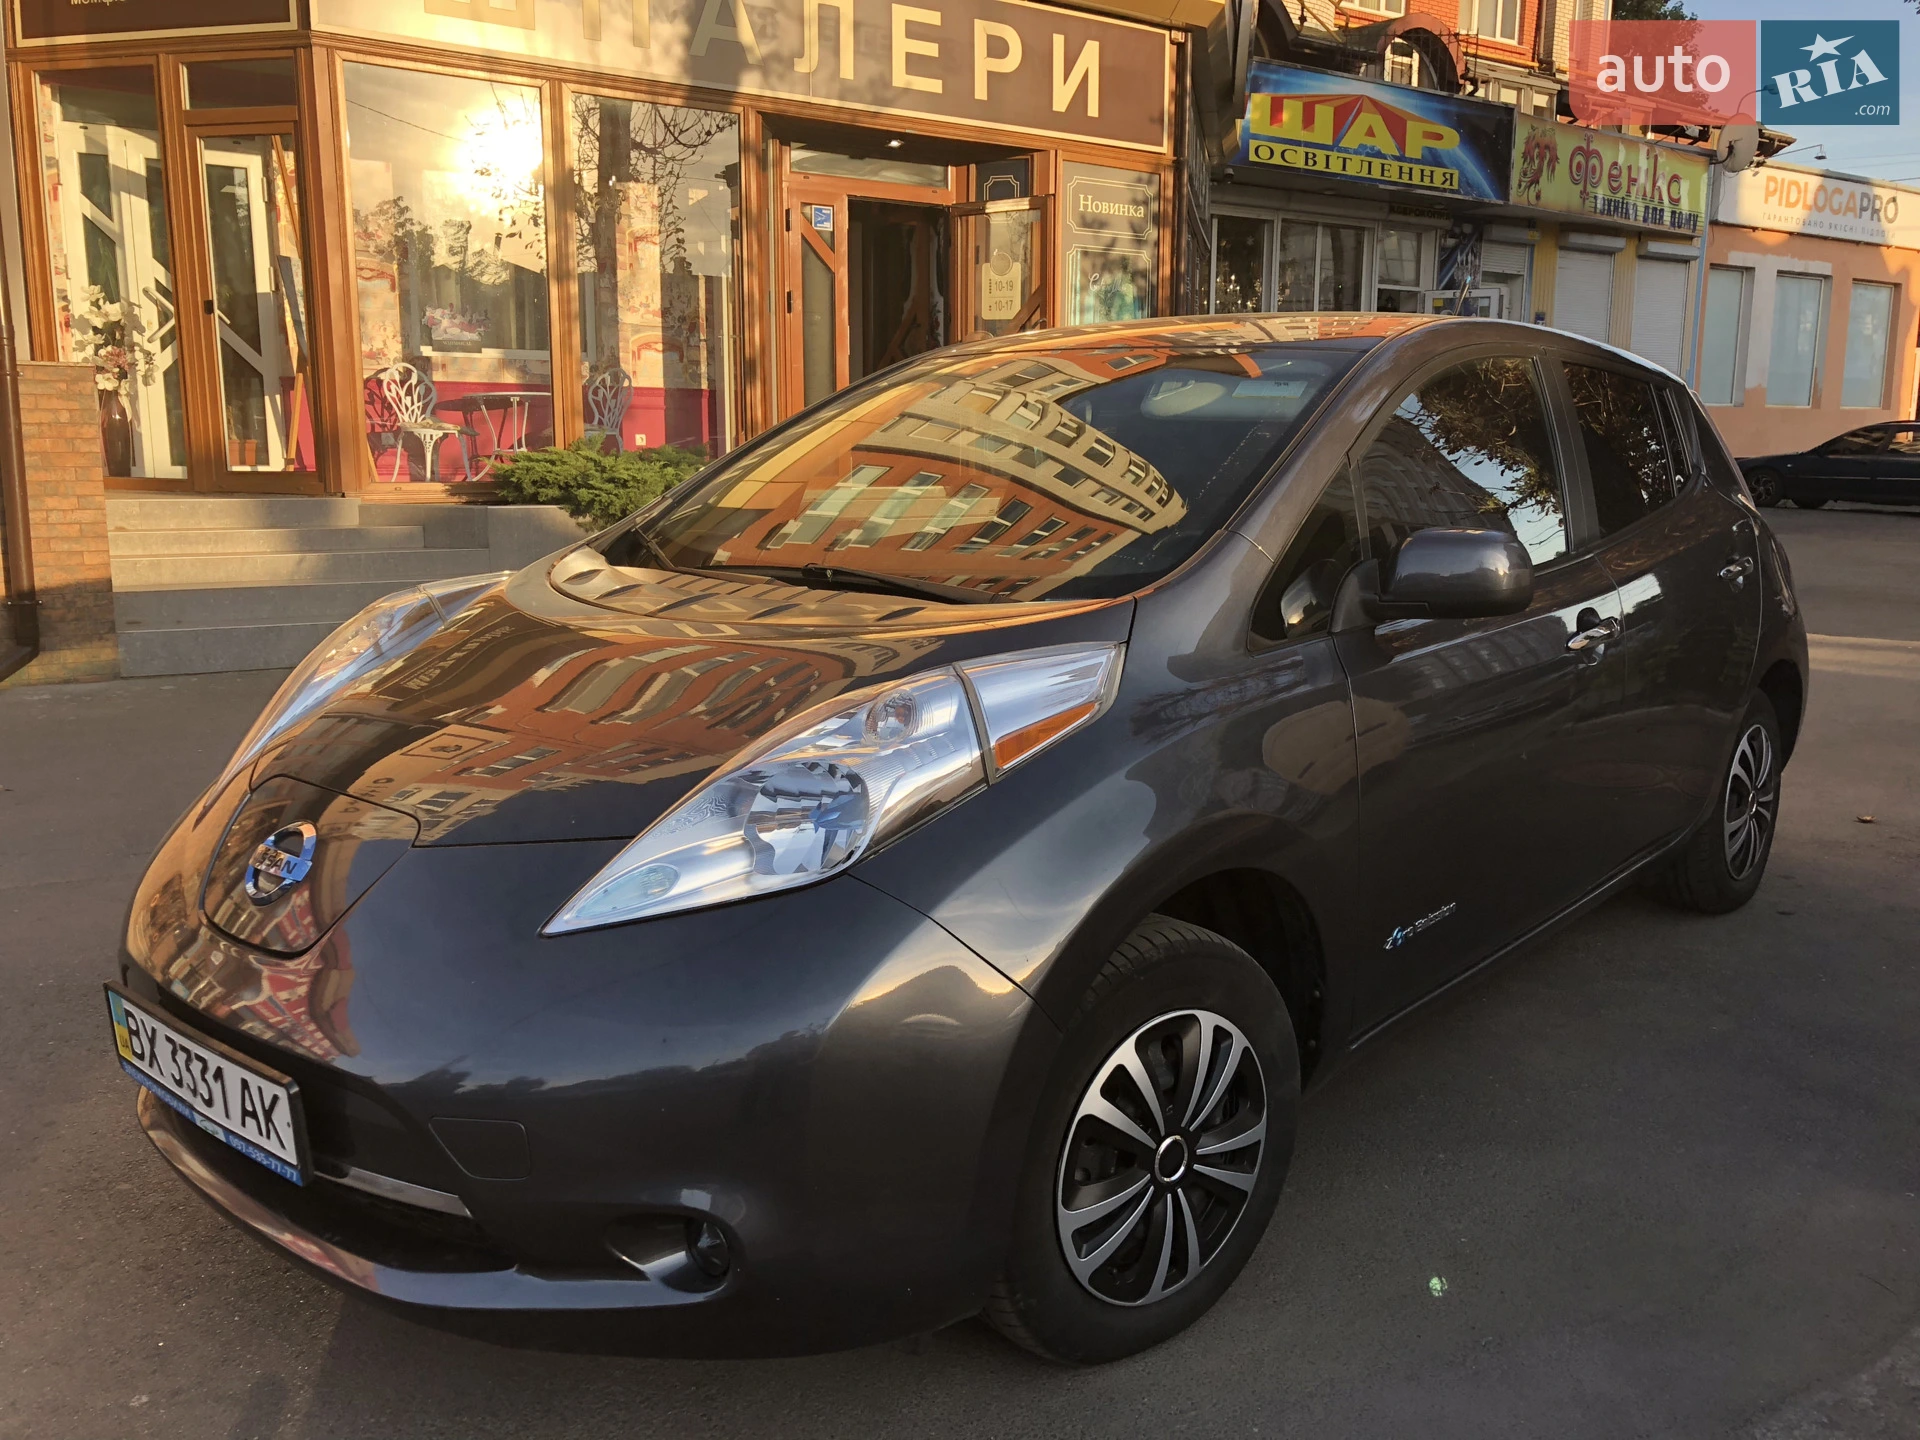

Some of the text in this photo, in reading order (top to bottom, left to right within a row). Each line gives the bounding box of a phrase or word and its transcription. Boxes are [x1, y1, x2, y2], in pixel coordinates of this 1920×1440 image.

[1250, 93, 1461, 160] ШАР
[1253, 144, 1455, 188] ОСВІТЛЕННЯ
[1078, 194, 1145, 218] Новинка
[994, 280, 1014, 292] 10-19
[994, 300, 1014, 312] 10-17
[119, 1035, 131, 1052] UA
[123, 1007, 165, 1078] BX
[164, 1033, 231, 1121] 3331
[240, 1076, 287, 1151] AK
